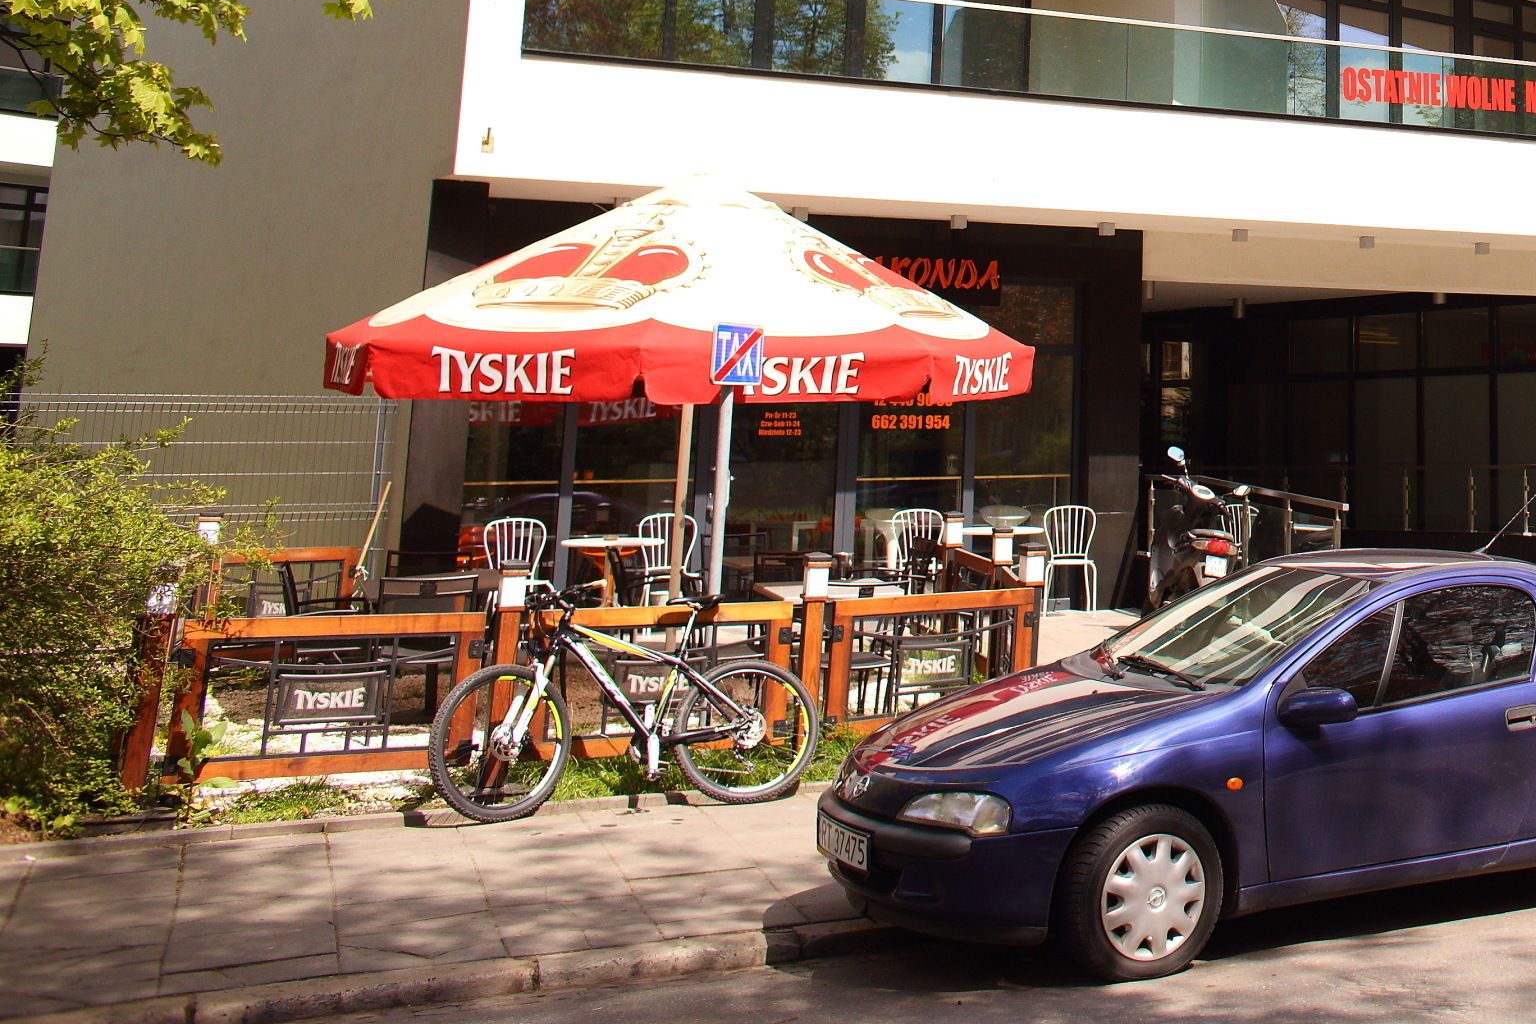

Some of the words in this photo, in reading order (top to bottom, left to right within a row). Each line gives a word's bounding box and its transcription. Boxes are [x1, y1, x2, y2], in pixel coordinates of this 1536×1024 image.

[1342, 67, 1441, 107] OSTATNIE
[1446, 75, 1517, 113] WOLNE
[875, 256, 1000, 291] KONDA
[431, 346, 575, 395] TYSKIE
[718, 331, 762, 377] TAXI
[743, 352, 865, 396] SKIE
[952, 351, 1013, 396] TYSKIE
[872, 414, 897, 429] 662
[900, 414, 923, 429] 391
[926, 414, 950, 429] 954
[909, 654, 957, 675] TYSKIE
[293, 686, 367, 711] TYSKIE
[834, 826, 865, 866] 37475
